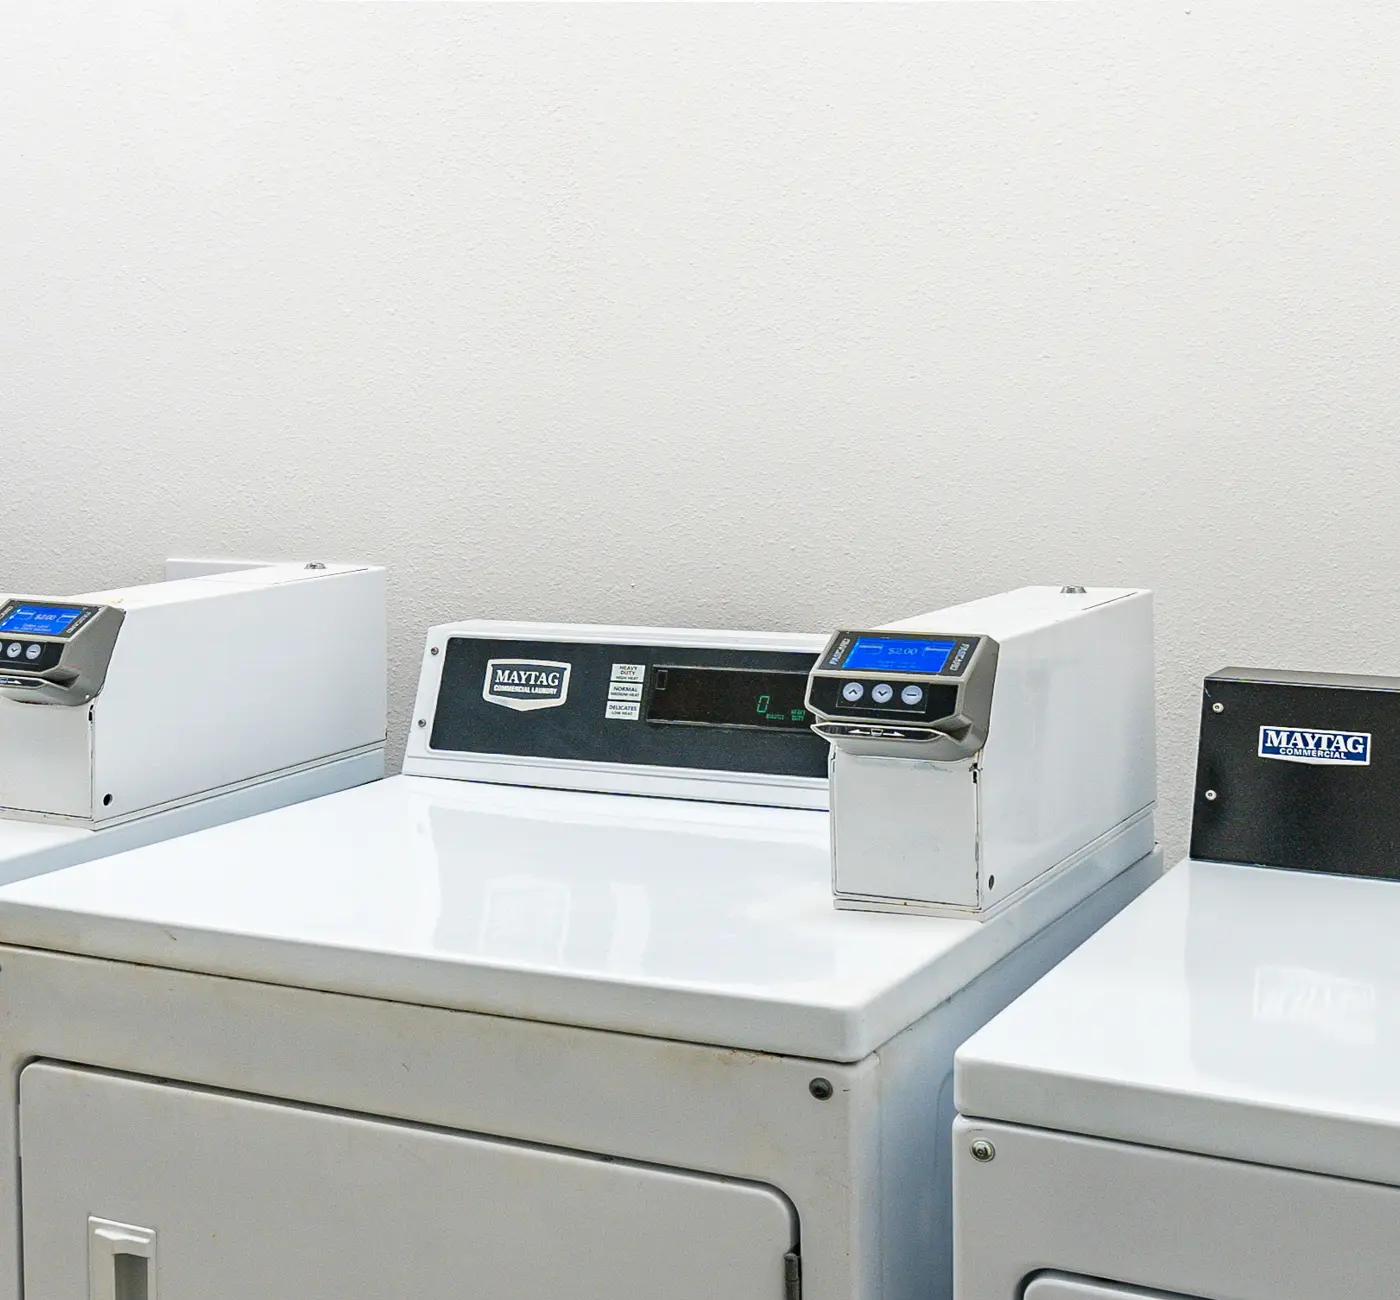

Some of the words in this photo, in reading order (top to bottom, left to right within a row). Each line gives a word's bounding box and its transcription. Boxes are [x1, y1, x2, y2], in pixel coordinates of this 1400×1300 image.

[887, 646, 918, 655] $2.00
[494, 669, 560, 686] MAYTAG
[493, 684, 531, 693] COMMERCIAL
[531, 687, 558, 695] LAUNDRY
[1264, 730, 1365, 754] MAYTAG
[1279, 748, 1347, 759] COMMERCIAL
